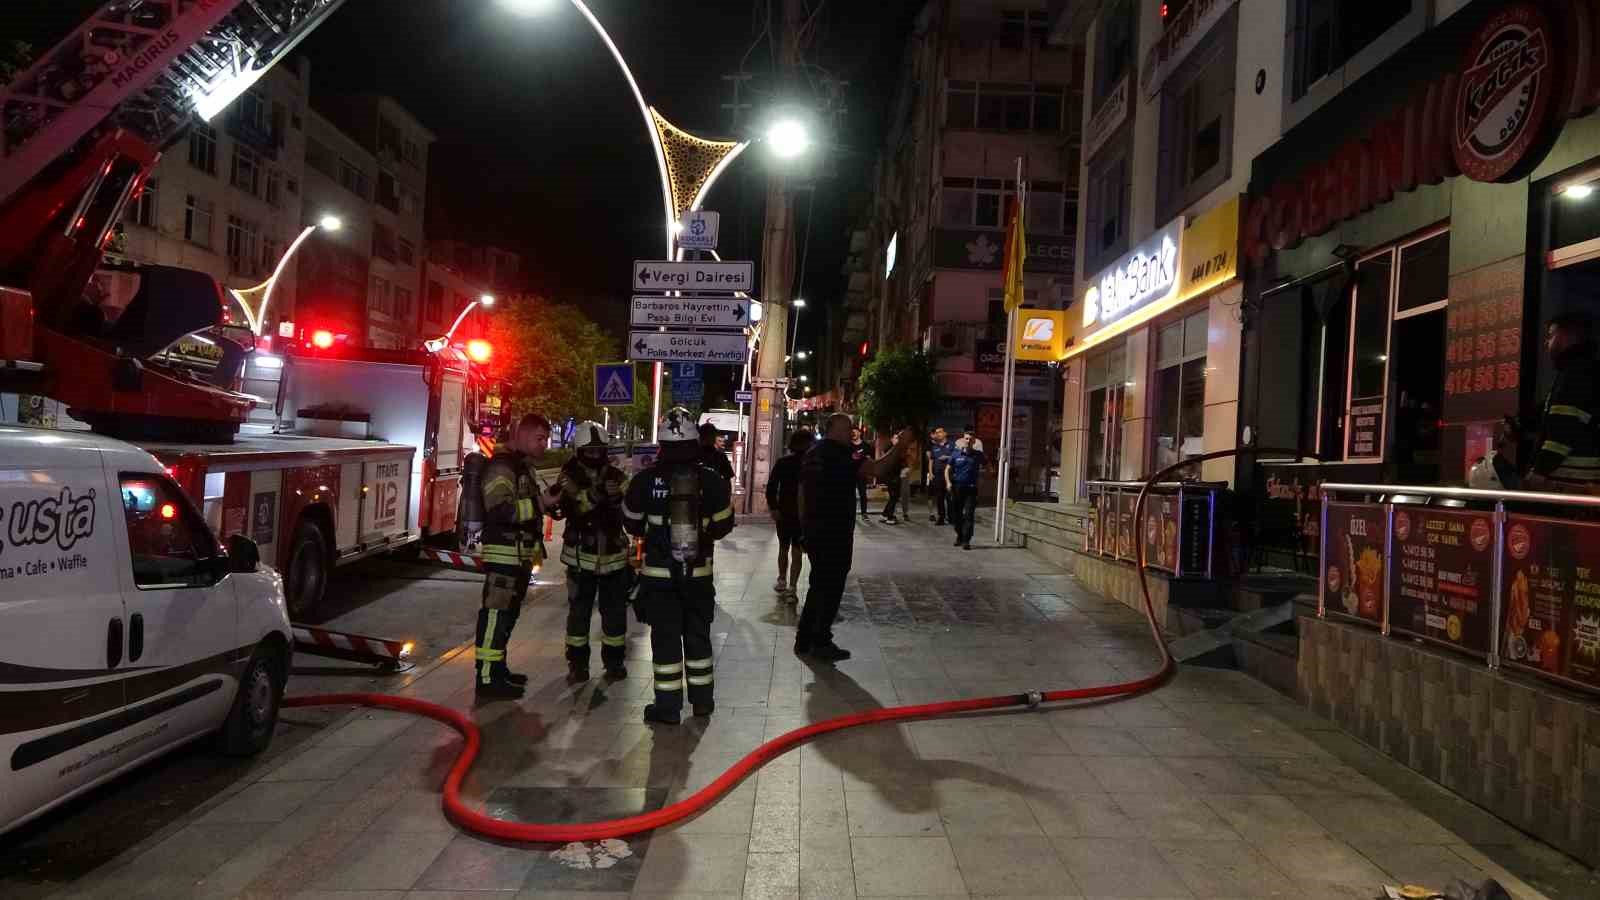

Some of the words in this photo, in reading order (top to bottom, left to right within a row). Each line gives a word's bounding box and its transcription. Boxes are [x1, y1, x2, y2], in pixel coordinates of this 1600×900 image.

[112, 29, 179, 88] MAGIRUS
[653, 271, 689, 285] Vergi
[695, 271, 745, 283] Dairesi
[635, 301, 679, 311] Barbaros
[683, 302, 730, 313] Hayrettin
[674, 314, 697, 325] Bilgi
[701, 314, 716, 323] Evi
[647, 348, 669, 358] Polis
[670, 349, 704, 359] Merkezi
[1445, 367, 1472, 394] 412
[374, 482, 400, 522] 112
[25, 560, 48, 576] Cafe
[57, 554, 87, 571] Waffle
